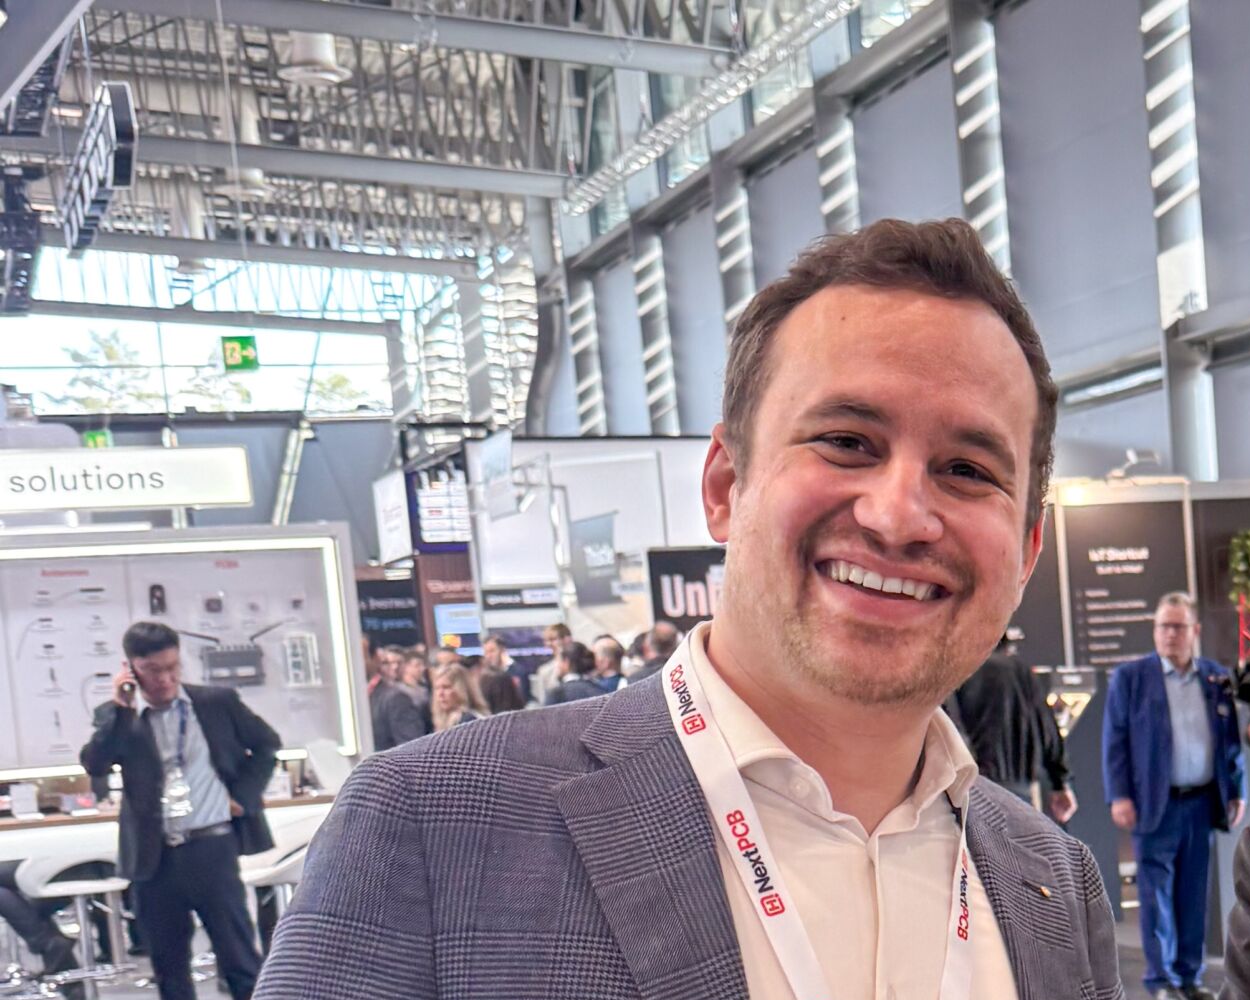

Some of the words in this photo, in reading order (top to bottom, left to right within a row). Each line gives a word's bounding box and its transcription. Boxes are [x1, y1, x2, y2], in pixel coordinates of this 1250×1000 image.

[10, 465, 165, 494] solutions
[669, 664, 698, 717] NextPCB
[726, 809, 775, 894] NextPCB
